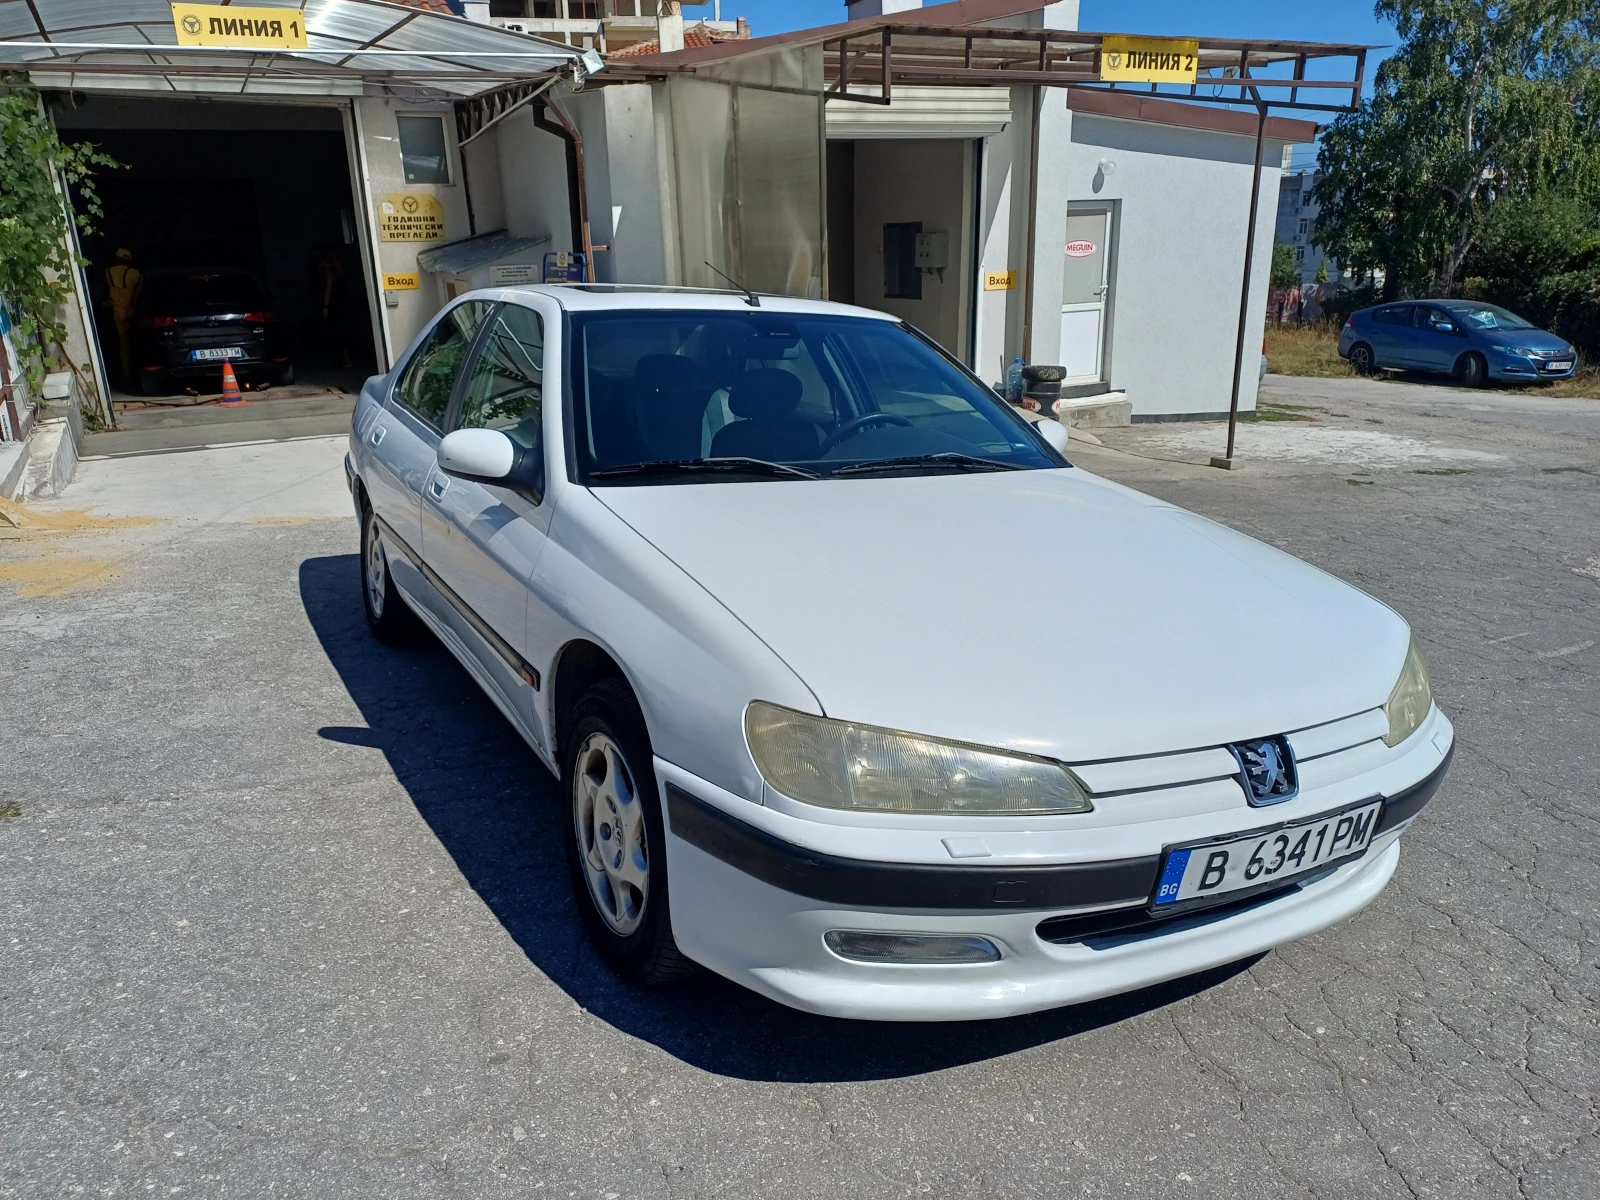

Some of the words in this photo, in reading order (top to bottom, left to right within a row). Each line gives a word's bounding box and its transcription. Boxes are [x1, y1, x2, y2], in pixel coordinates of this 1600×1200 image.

[209, 17, 283, 38] ЛИНИЯ
[289, 21, 299, 38] 1
[1126, 51, 1180, 71] ЛИНИЯ
[1184, 53, 1193, 71] 2
[388, 277, 414, 286] Вход
[989, 276, 1012, 286] Вход
[1197, 850, 1229, 891] B
[1159, 882, 1178, 897] BG
